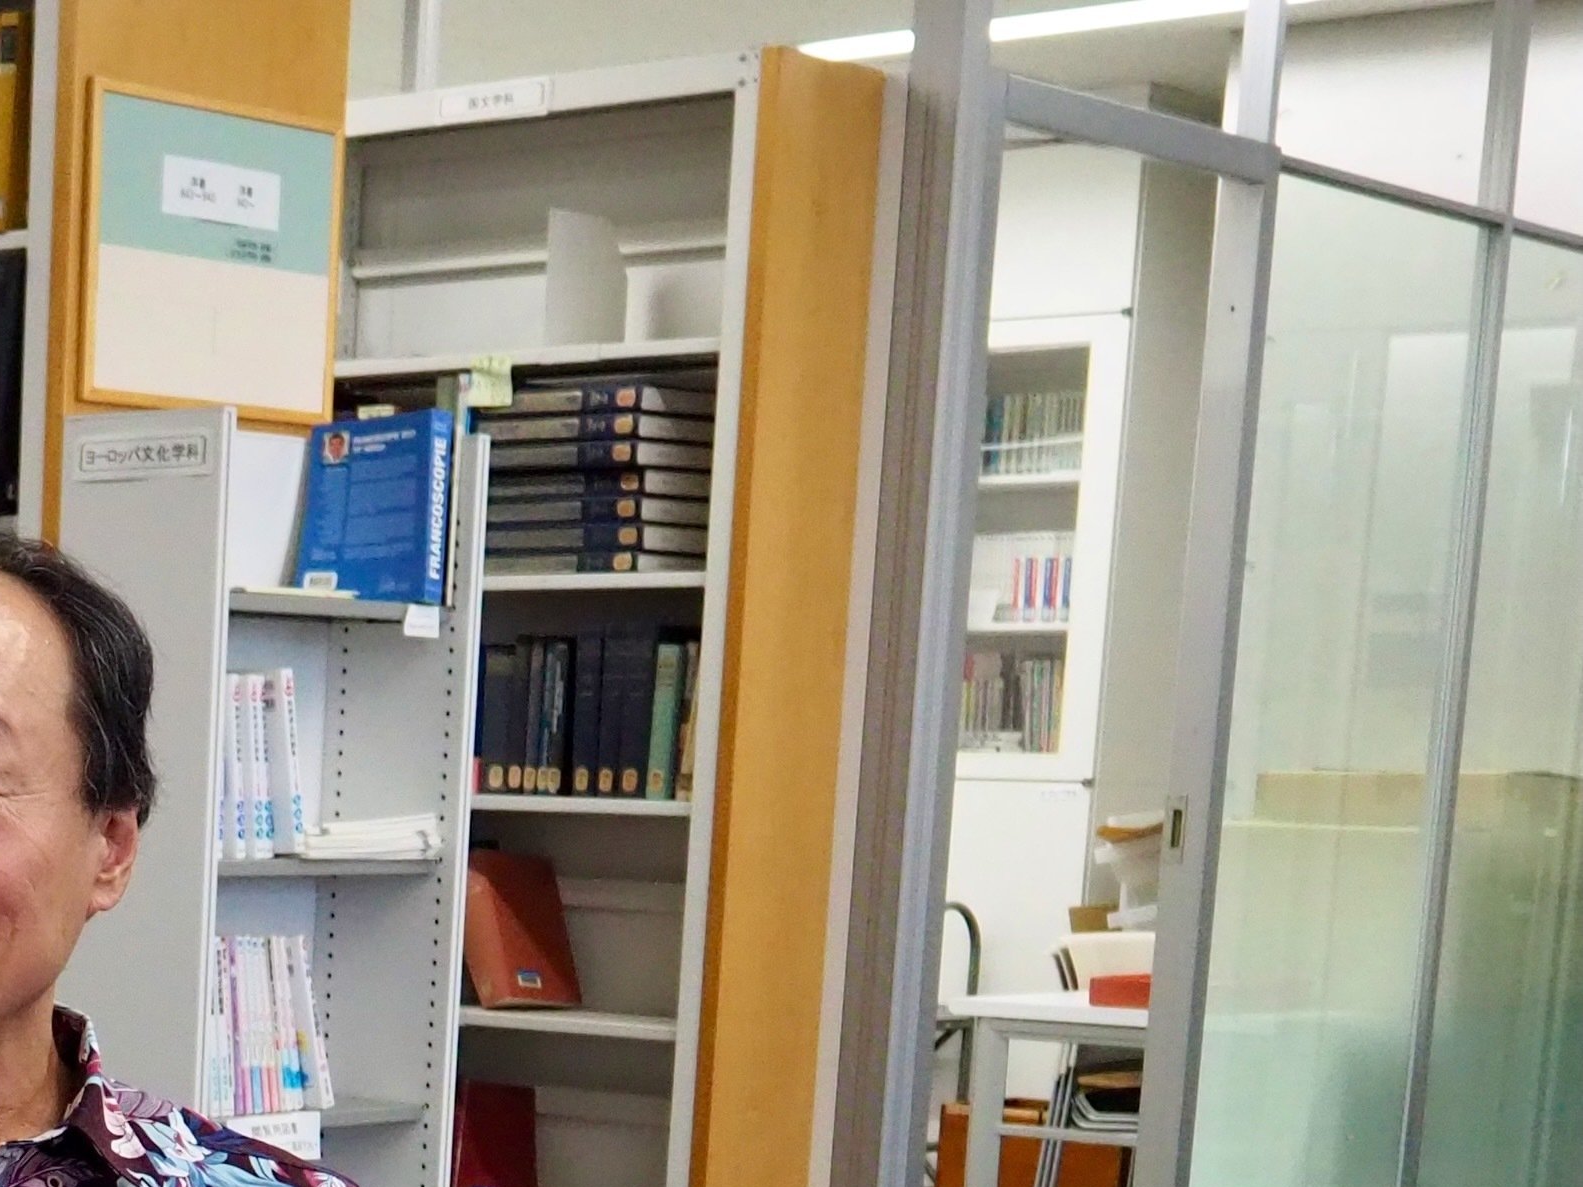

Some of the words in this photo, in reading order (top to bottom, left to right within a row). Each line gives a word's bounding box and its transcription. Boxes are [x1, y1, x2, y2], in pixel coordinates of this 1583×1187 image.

[85, 443, 199, 465] ヨーロッパ文化学科
[428, 436, 448, 581] FRANCOSCOPIE
